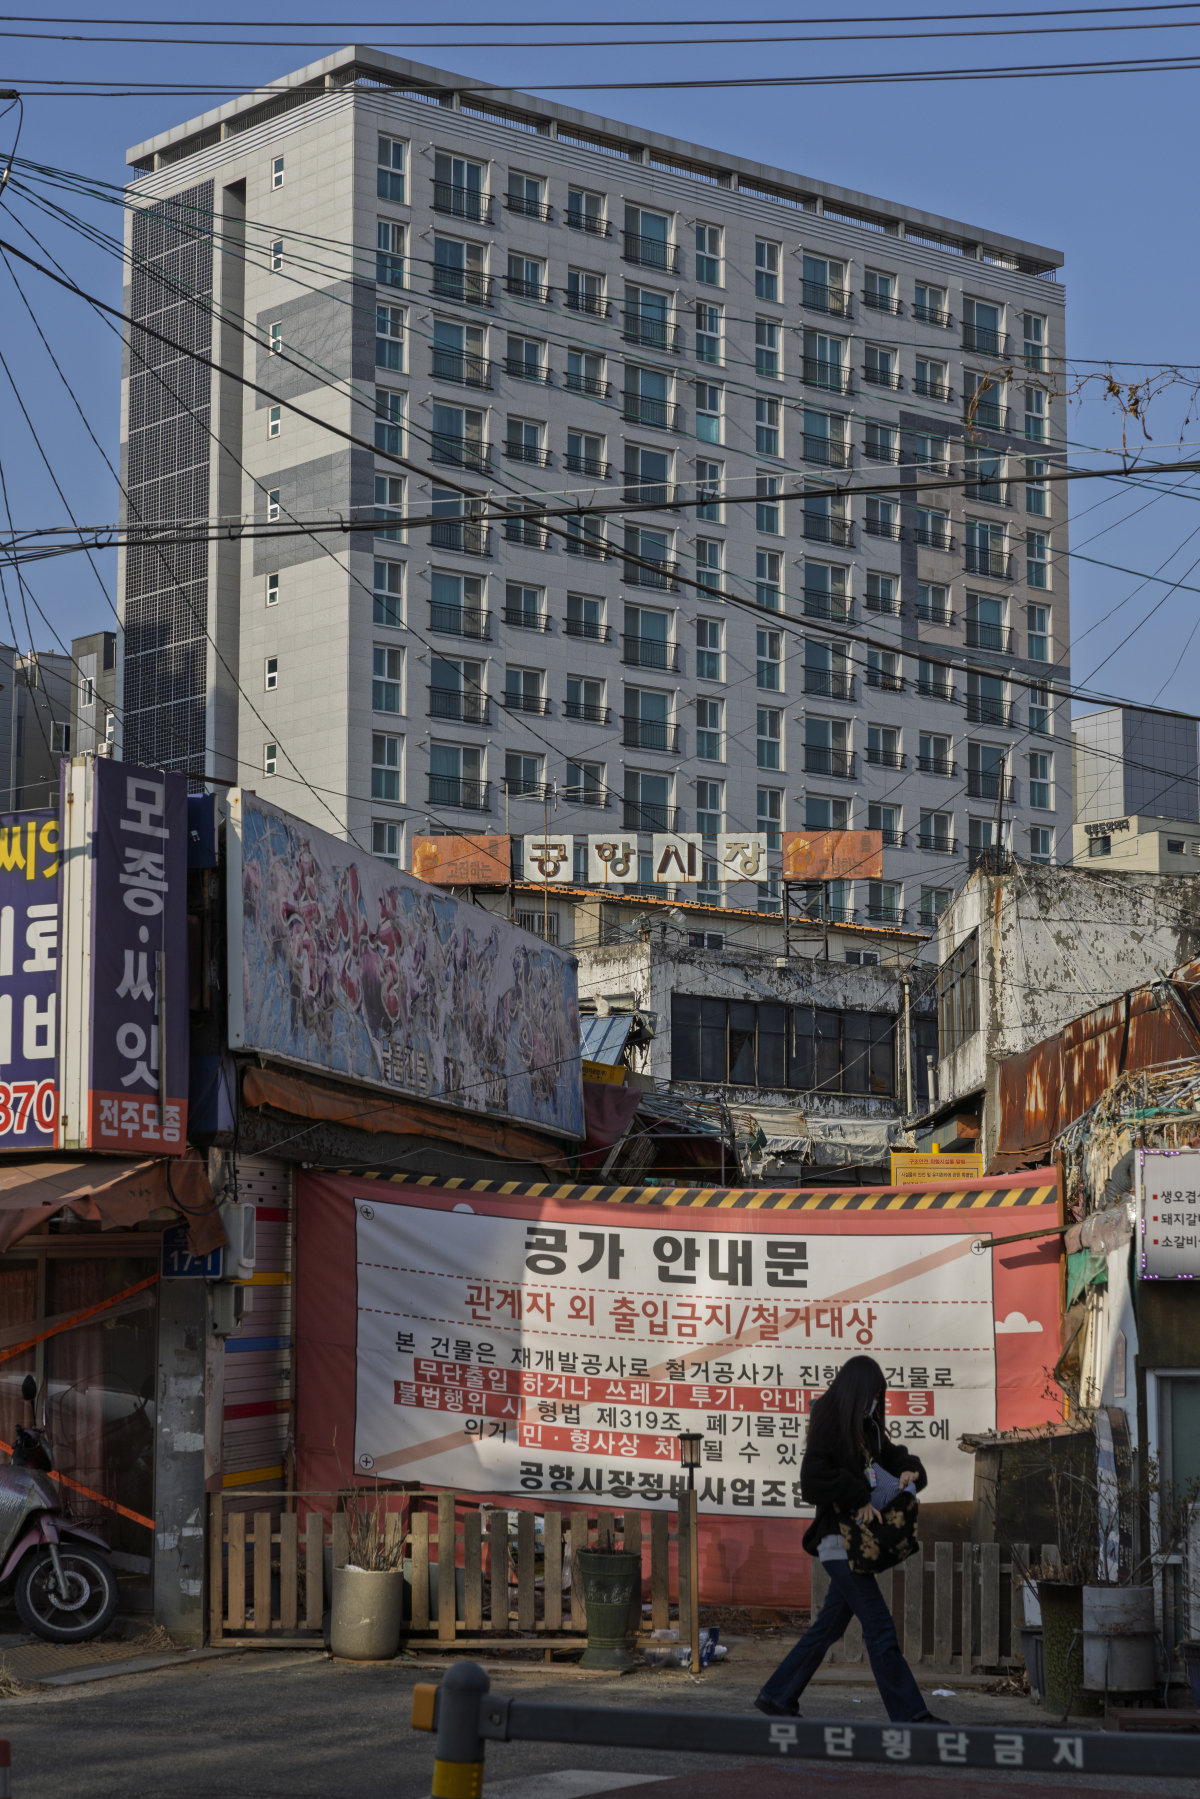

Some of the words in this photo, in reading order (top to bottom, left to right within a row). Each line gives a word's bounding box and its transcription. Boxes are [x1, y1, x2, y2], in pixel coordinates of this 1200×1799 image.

[530, 842, 765, 877] 공항시장
[100, 1099, 181, 1142] 전주모종
[1161, 1190, 1200, 1204] 생오겹
[1161, 1213, 1200, 1227] 돼지갈
[169, 1250, 213, 1273] 17-1
[525, 1226, 625, 1280] 공가
[653, 1235, 809, 1289] 안내문
[1161, 1236, 1200, 1249] 소갈비
[464, 1284, 556, 1323] 관계자
[567, 1295, 595, 1326] 외
[608, 1296, 878, 1345] 출입금지/철거대상
[395, 1331, 416, 1354] 본
[430, 1337, 497, 1365] 건물은
[511, 1347, 650, 1378] 재개발공사로
[665, 1359, 784, 1386] 철거공사가
[398, 1382, 487, 1415] 불법행위
[501, 1397, 522, 1419] 시
[536, 1400, 581, 1426] 형법
[417, 1359, 508, 1393] 무단출입
[522, 1373, 592, 1400] 하거나
[605, 1380, 675, 1407] 쓰레기
[689, 1385, 745, 1412] 투기,
[905, 1392, 929, 1415] 등
[464, 1418, 507, 1444] 의거
[654, 1435, 723, 1463] 처될
[738, 1441, 761, 1464] 수
[768, 1723, 1085, 1769] 무단횡단금지
